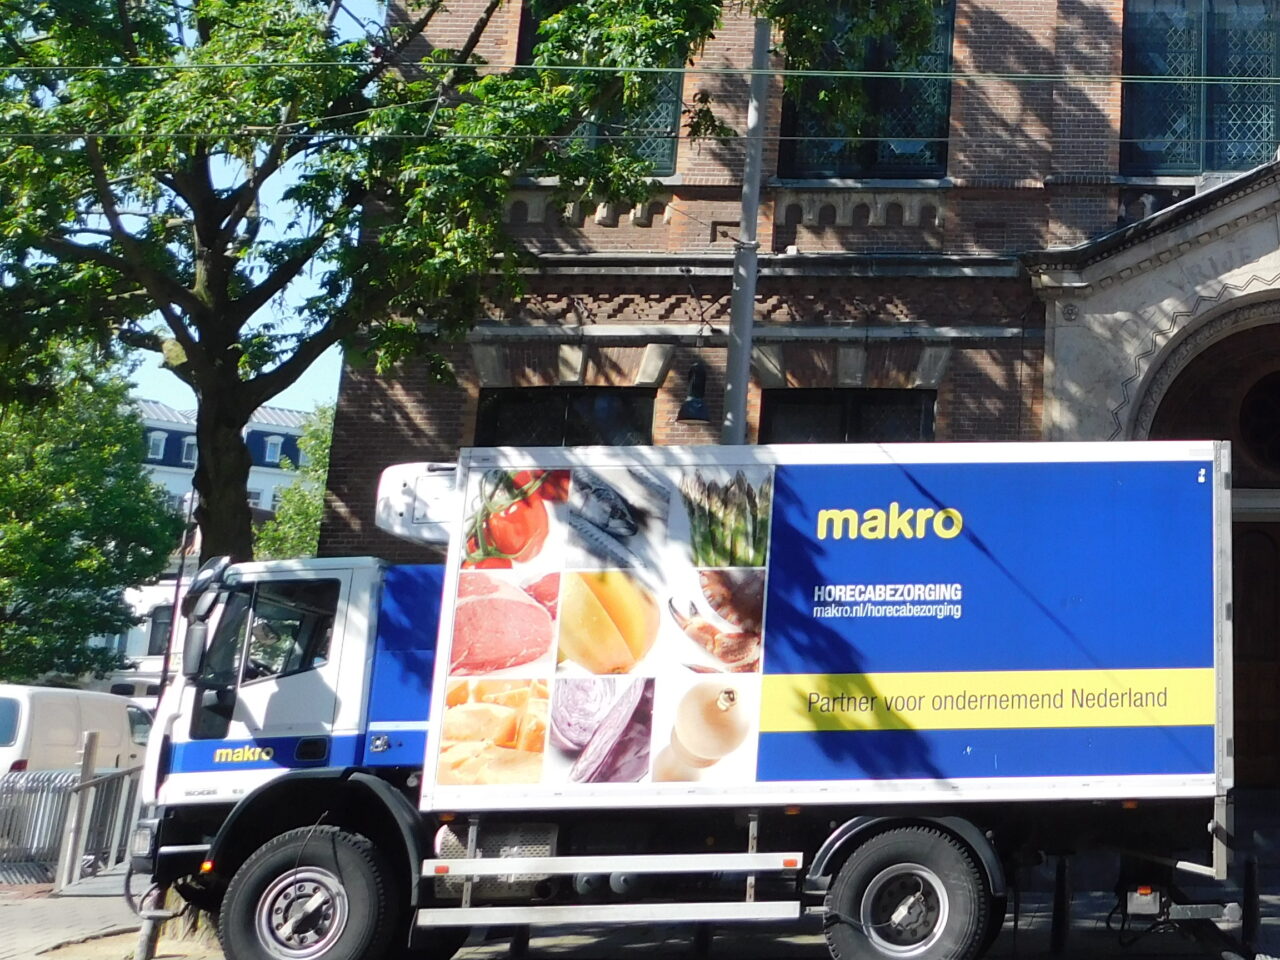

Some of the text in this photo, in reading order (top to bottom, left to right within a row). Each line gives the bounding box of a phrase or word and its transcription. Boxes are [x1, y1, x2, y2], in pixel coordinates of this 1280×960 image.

[816, 501, 964, 541] makro
[813, 583, 962, 602] HORECABEZORGING
[812, 602, 962, 620] makro.nl/horecabezorging
[807, 687, 1169, 714] Partner voor ondernemend Nederland
[214, 745, 275, 763] makro
